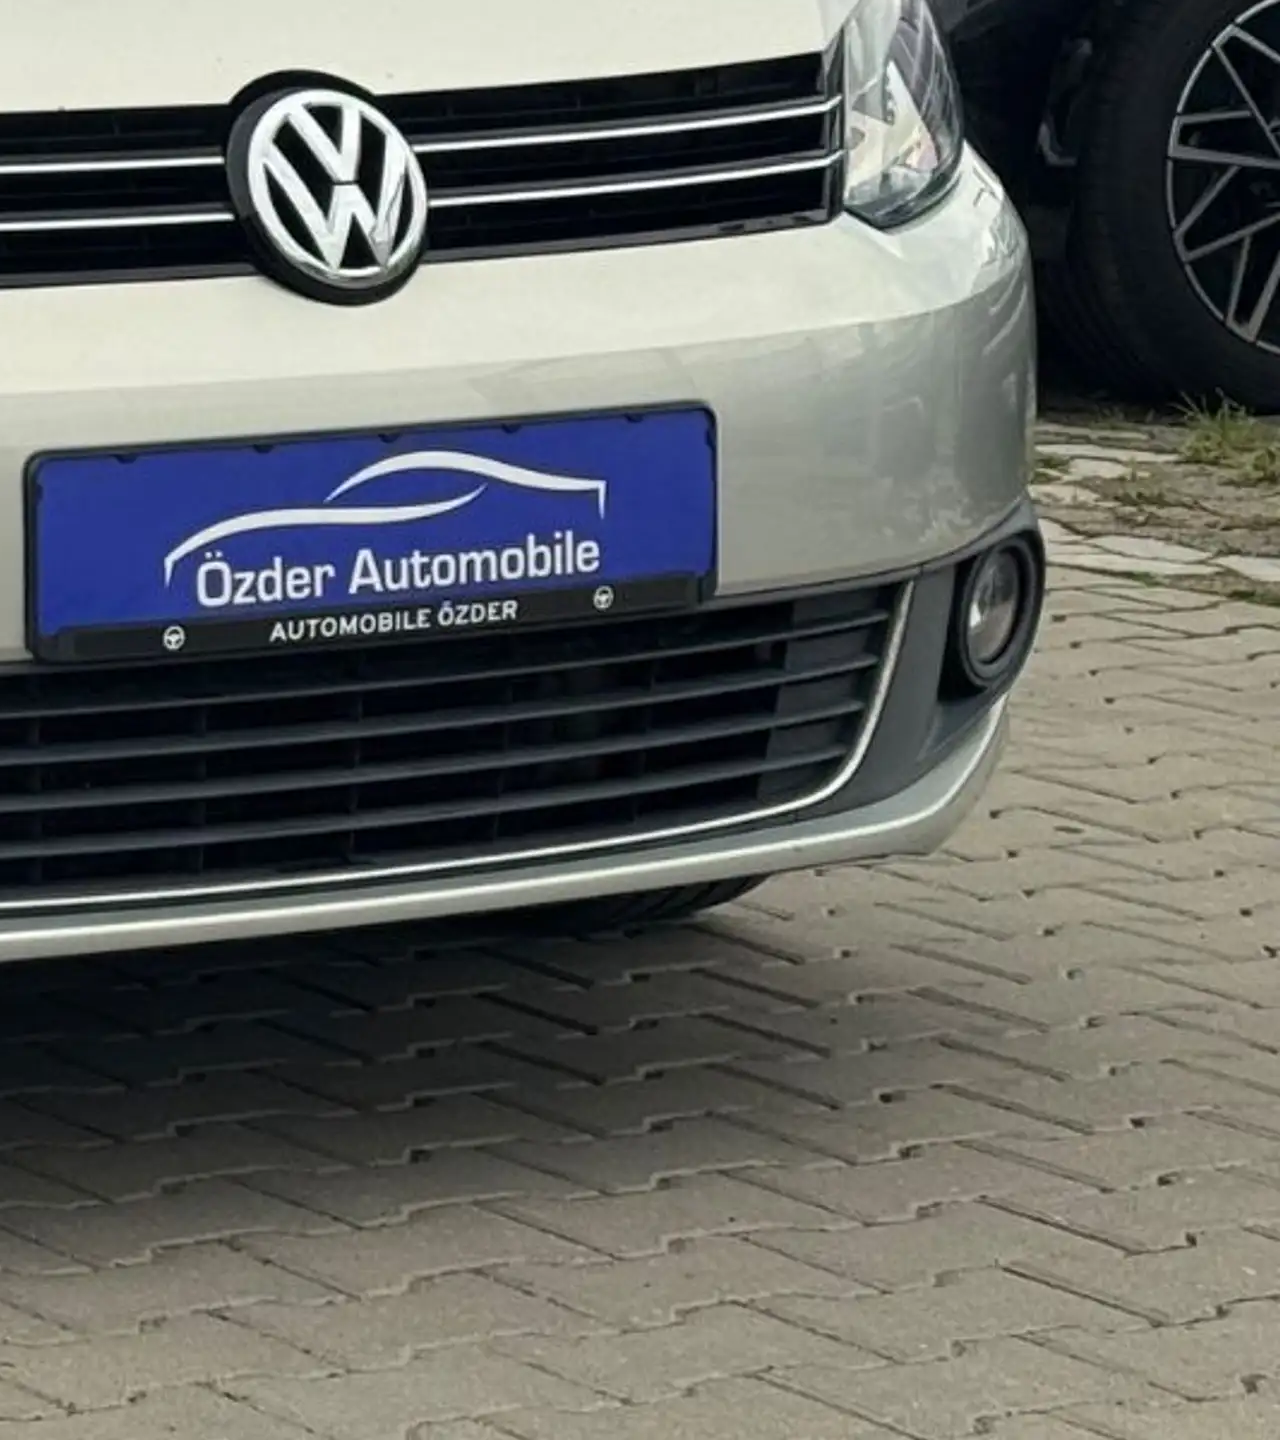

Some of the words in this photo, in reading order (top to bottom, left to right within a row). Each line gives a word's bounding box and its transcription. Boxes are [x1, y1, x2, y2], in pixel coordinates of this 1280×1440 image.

[196, 550, 336, 608] Özder
[348, 529, 601, 595] Automobile
[269, 608, 432, 643] AUTOMOBILE
[437, 599, 519, 627] ÖZDER
